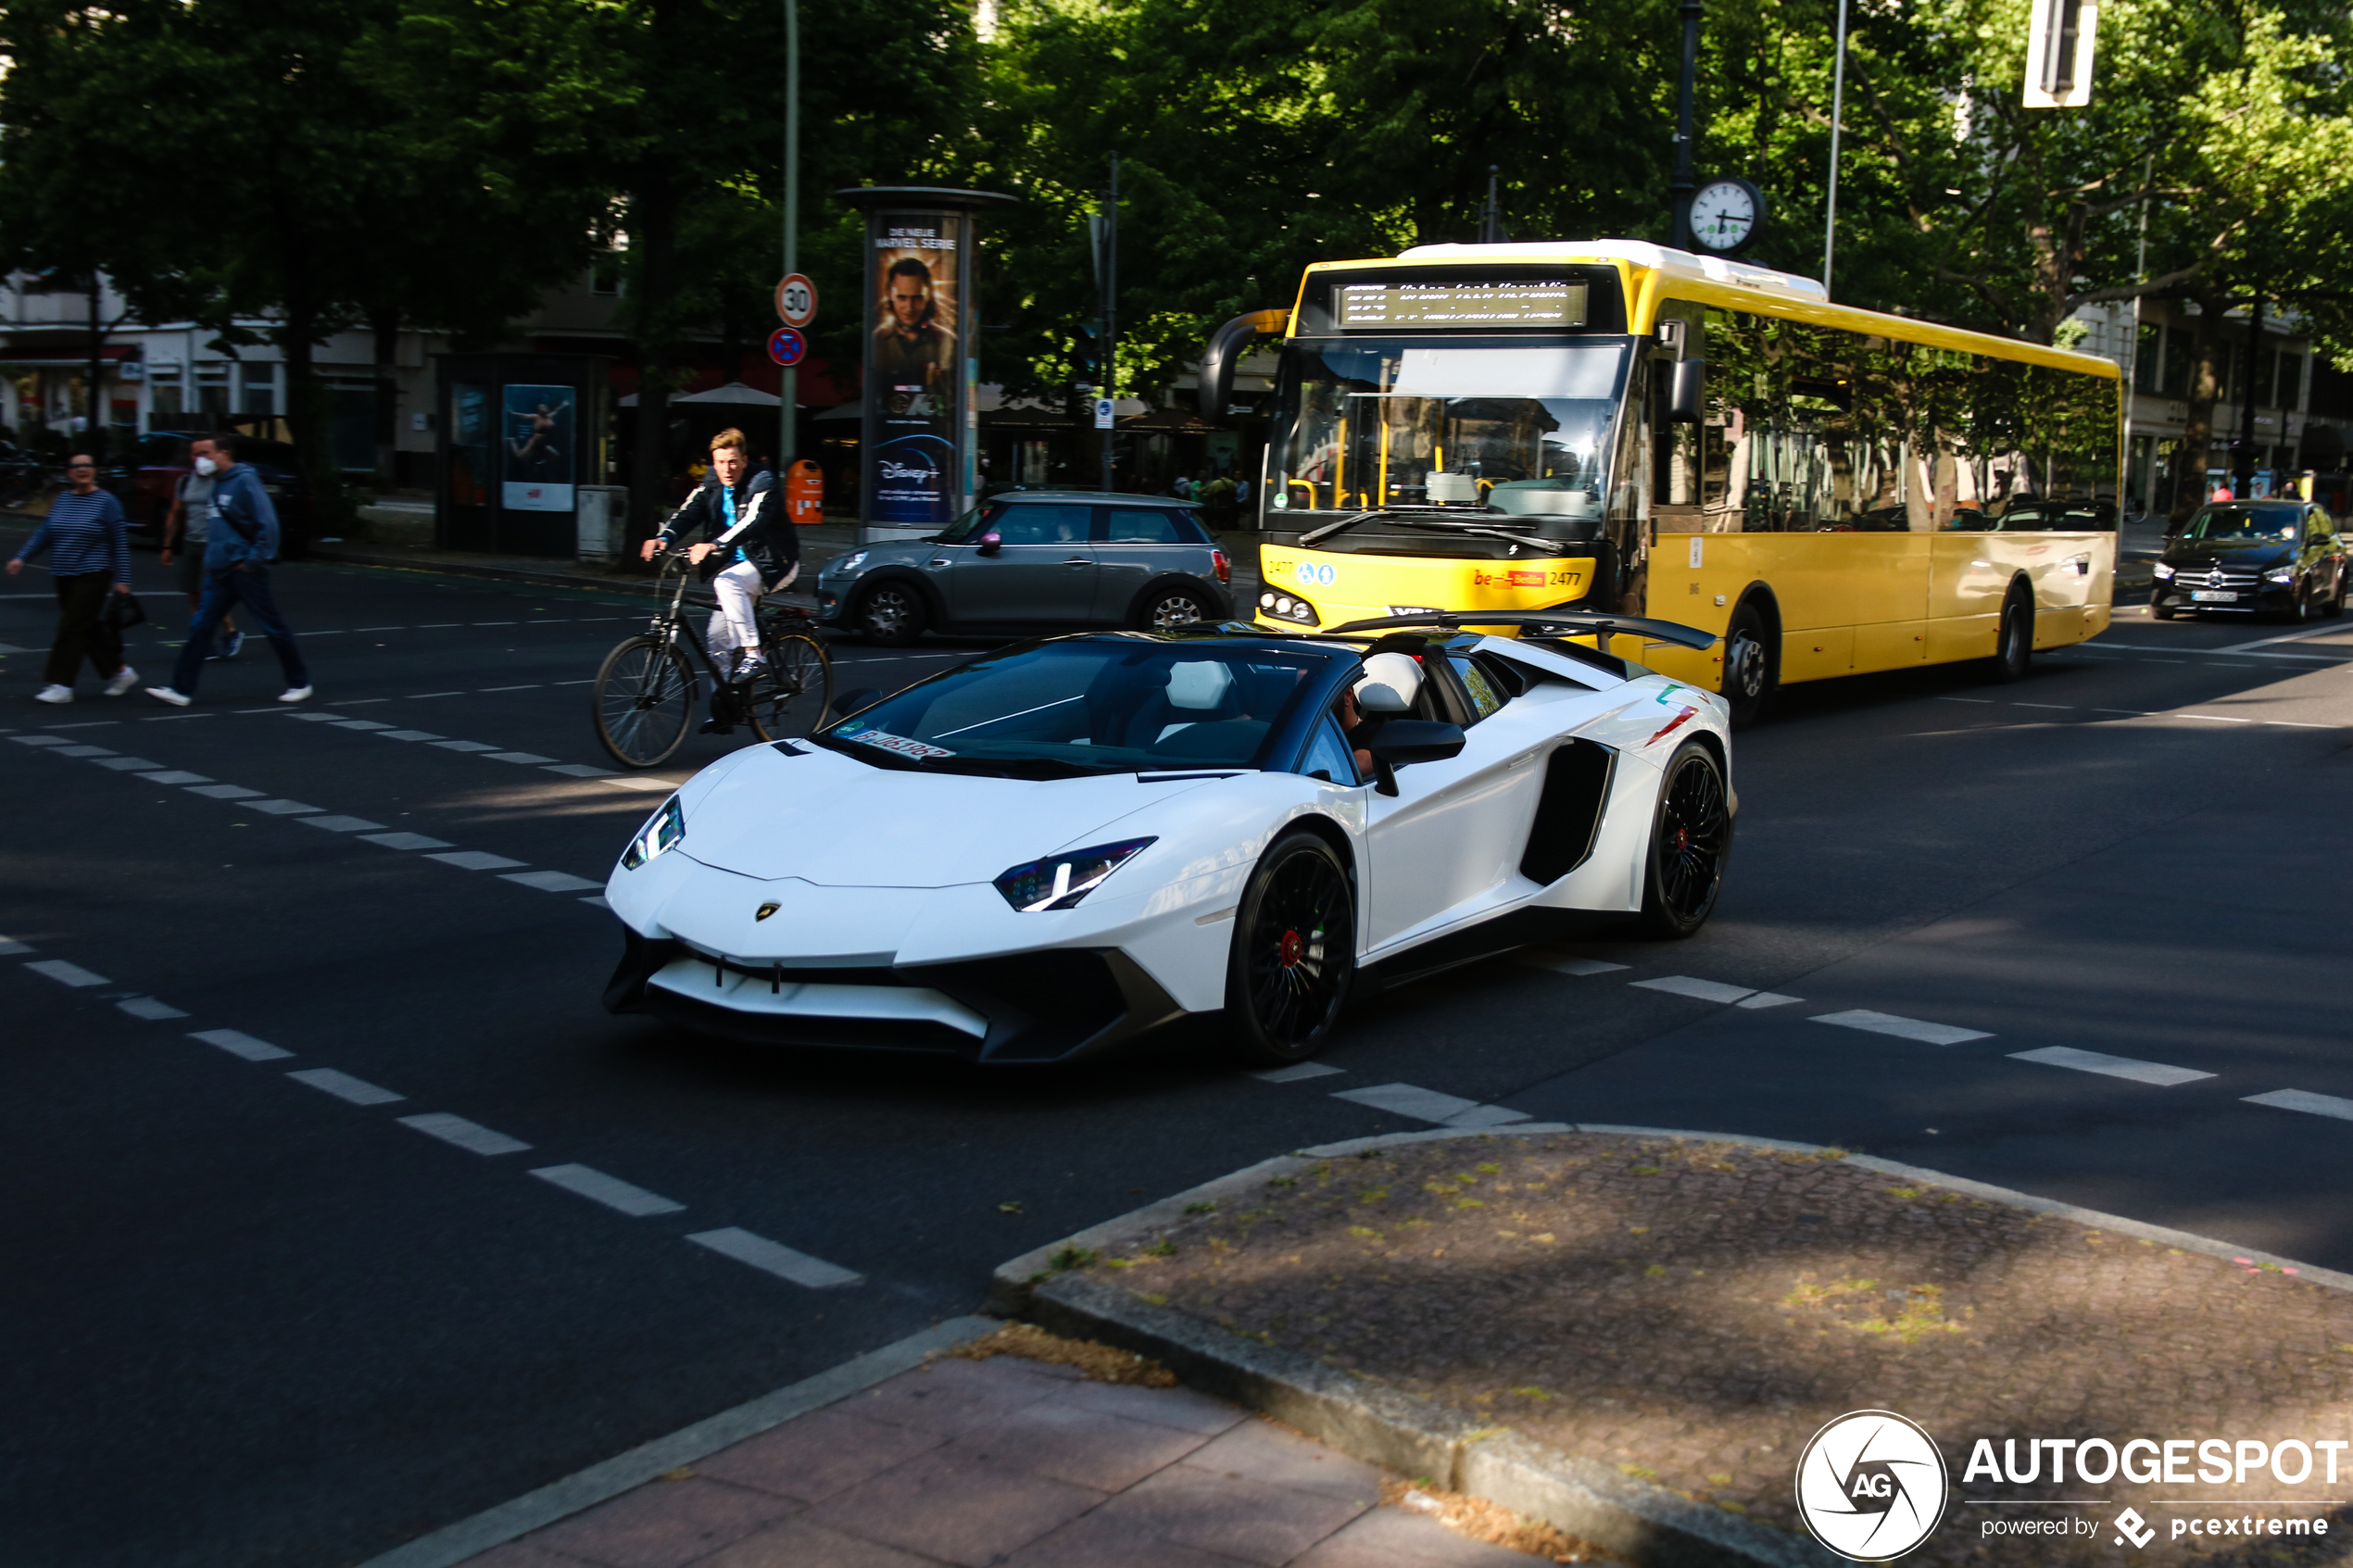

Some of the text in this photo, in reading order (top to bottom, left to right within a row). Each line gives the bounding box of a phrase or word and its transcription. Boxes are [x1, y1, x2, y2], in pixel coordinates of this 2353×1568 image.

[875, 237, 956, 250] MARVEL SERIE
[785, 288, 809, 313] 30
[1474, 569, 1492, 585] be
[1550, 571, 1582, 586] 2477
[851, 732, 878, 742] B
